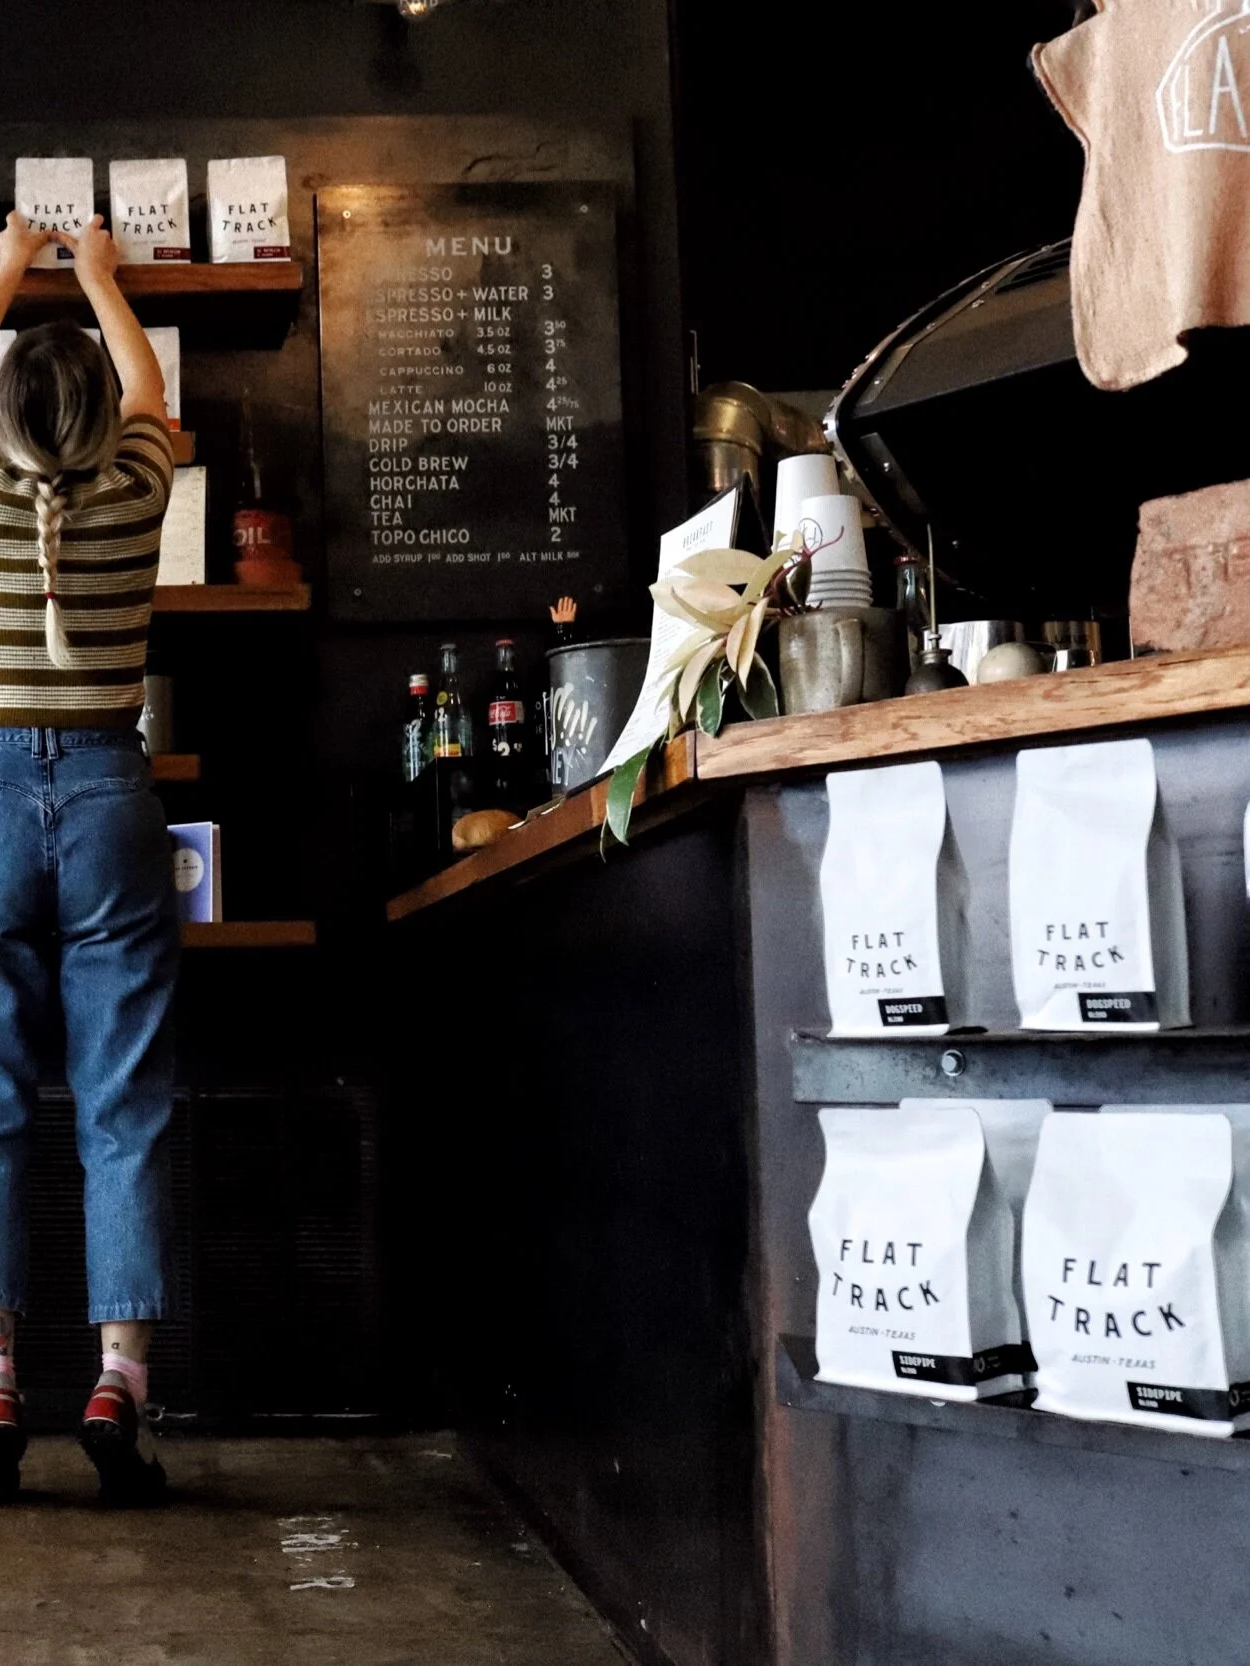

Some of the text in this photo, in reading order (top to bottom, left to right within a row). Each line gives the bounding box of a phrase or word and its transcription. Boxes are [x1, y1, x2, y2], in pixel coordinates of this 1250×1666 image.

[34, 204, 75, 215] FLAT
[128, 204, 169, 216] FLAT
[228, 203, 269, 215] FLAT
[28, 218, 82, 232] TRACK
[122, 218, 177, 234] TRACK
[222, 217, 277, 233] TRACK
[426, 236, 512, 257] MENU
[542, 264, 553, 280] 3
[472, 286, 529, 301] WATER
[542, 285, 554, 301] 3
[474, 306, 512, 322] MILK
[497, 327, 511, 337] OZ
[378, 347, 442, 357] CORTADO
[497, 344, 511, 355] OZ
[379, 358, 556, 377] CAPPUCCINO 6 OZ 4
[380, 385, 423, 395] LATTE
[484, 382, 496, 393] 10
[499, 382, 512, 393] OZ
[368, 399, 444, 416] MEXICAN
[451, 398, 510, 414] MOCHA
[368, 416, 574, 434] MADE TO ORDER MKT
[369, 434, 578, 453] DRIP 3/4
[369, 453, 579, 472] COLD BREW 3/4
[370, 473, 560, 491] HORCHATA 4
[370, 491, 560, 509] CHAI 4
[371, 506, 577, 526] TEA MKT
[233, 527, 271, 547] OIL
[372, 526, 561, 546] TOPO CHICO 2
[372, 553, 391, 564] ADD
[394, 553, 422, 563] SYRUP
[446, 553, 464, 563] ADD
[467, 553, 491, 562] SHOT
[519, 552, 537, 562] ALT
[540, 552, 564, 562] MILK
[1046, 921, 1109, 941] FLAT
[851, 932, 904, 950] FLAT
[846, 954, 917, 978] TRACK
[1037, 945, 1124, 971] TRACK
[840, 1238, 923, 1267] FLAT
[1062, 1257, 1162, 1289] FLAT
[832, 1271, 941, 1312] TRACK
[1047, 1294, 1186, 1338] TRACK
[899, 1355, 936, 1369] SIDEPIPE
[1136, 1386, 1183, 1402] SIDEPIPE
